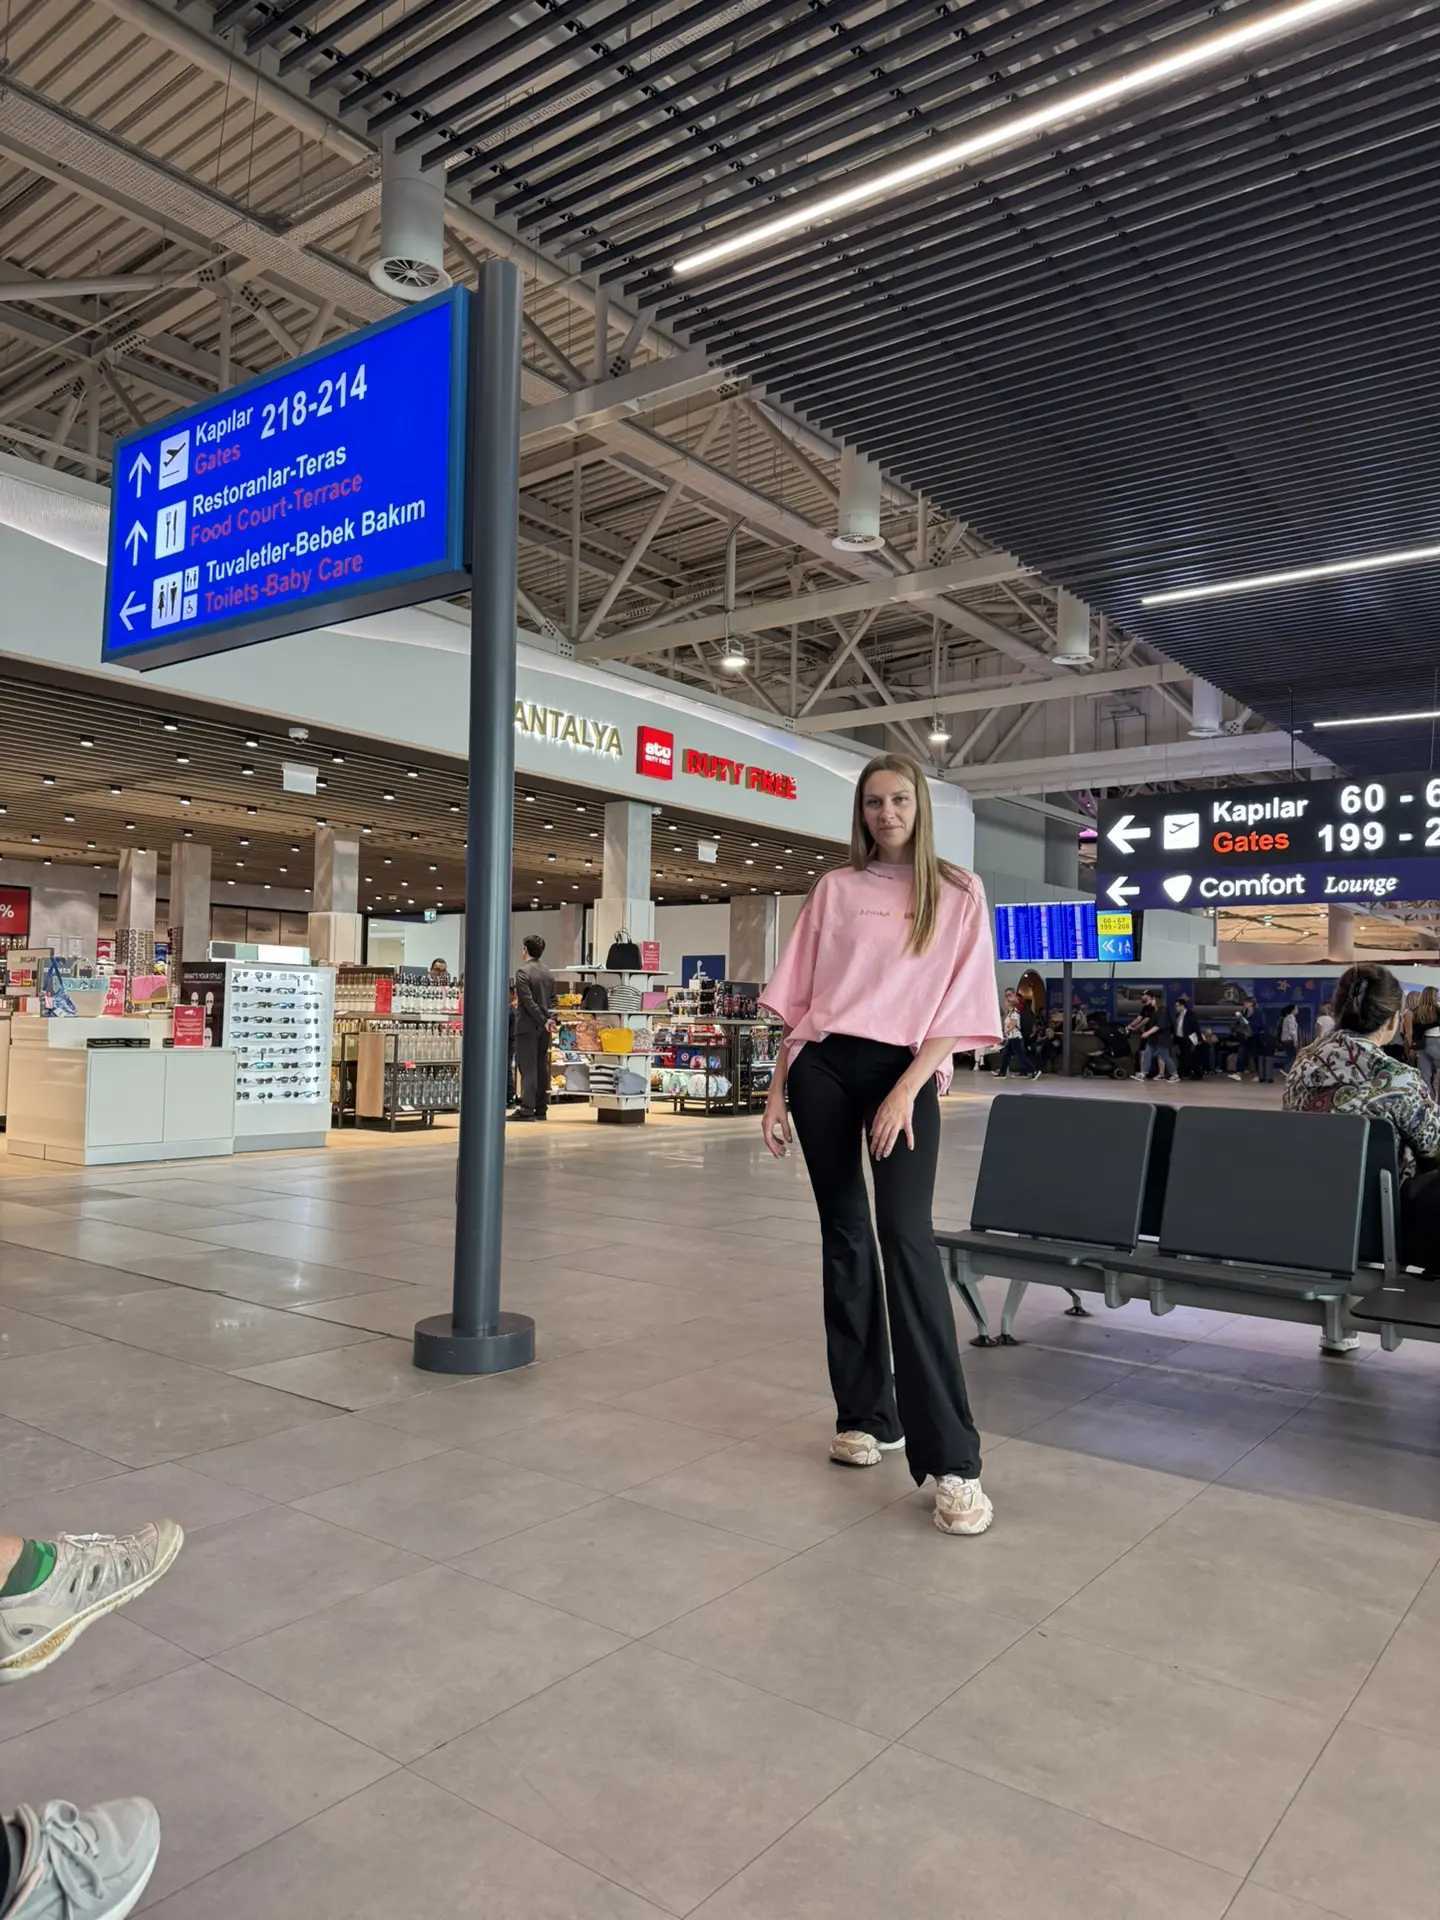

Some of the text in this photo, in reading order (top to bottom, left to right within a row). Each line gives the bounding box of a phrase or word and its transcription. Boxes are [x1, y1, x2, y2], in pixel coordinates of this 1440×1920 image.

[195, 363, 367, 447] Kapılar 218-214
[192, 446, 347, 518] Restoranlar-Teras
[194, 444, 241, 475] Gates
[190, 474, 363, 547] Food Court-Terrace
[206, 499, 426, 583] Tuvaletler-Bebek Bakım
[204, 554, 364, 613] Toilets-Baby Care
[514, 700, 624, 756] ANTALYA
[682, 748, 798, 800] DUTY FREE
[1213, 797, 1309, 826] Kapılar
[1341, 783, 1385, 815] 60
[1213, 831, 1290, 853] Gates
[1318, 821, 1385, 852] 199
[1200, 872, 1399, 898] Comfort Lounge
